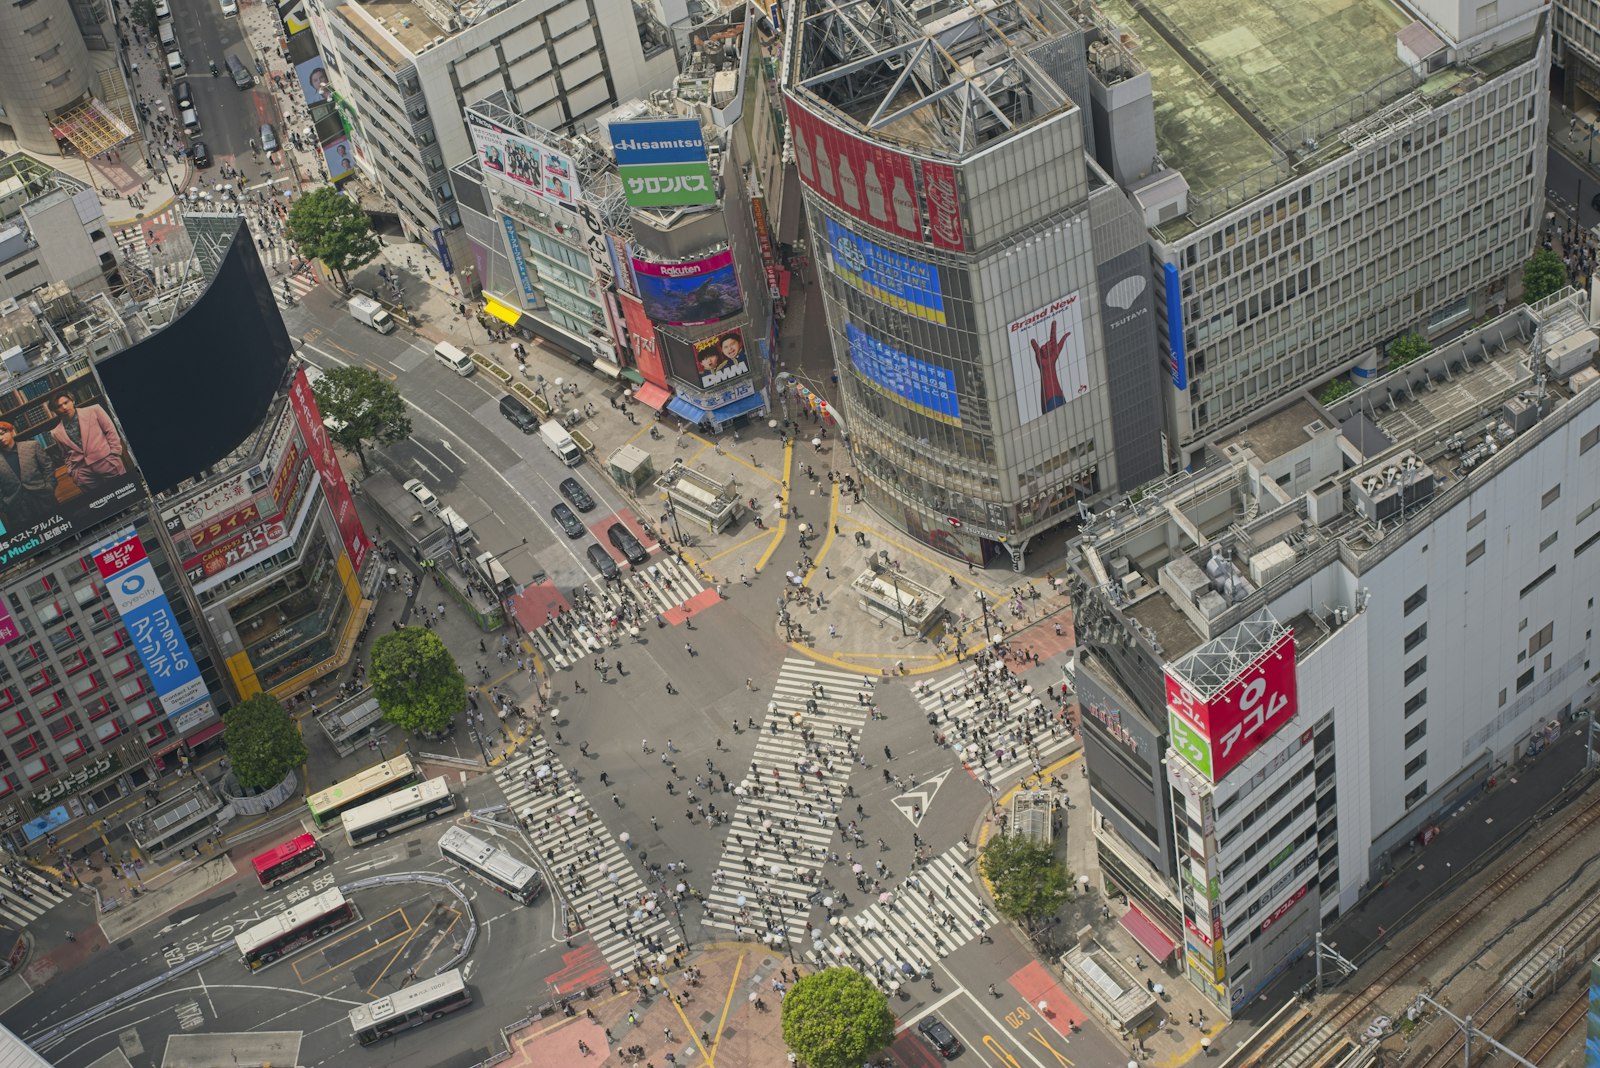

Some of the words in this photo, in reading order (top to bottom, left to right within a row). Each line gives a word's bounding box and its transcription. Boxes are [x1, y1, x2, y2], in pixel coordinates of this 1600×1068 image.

[614, 138, 703, 151] Hisamitsu
[627, 175, 709, 194] サロンパス
[660, 264, 701, 277] Rakuten
[1011, 308, 1047, 332] Brand
[1050, 295, 1077, 312] New
[1110, 307, 1148, 330] TSUTAYA
[702, 361, 749, 388] DMM
[89, 492, 115, 508] amazon
[115, 482, 135, 496] music
[204, 484, 245, 511] しゃぶ葉
[1022, 465, 1097, 508] STARBUCKS
[10, 514, 64, 544] ベストアルバム
[167, 520, 181, 530] 9F
[103, 544, 135, 565] 当ビル
[114, 554, 131, 569] 5F
[225, 538, 263, 564] ガスト
[188, 568, 203, 580] 7F
[121, 587, 156, 608] eyecity
[131, 616, 172, 677] アイシティ
[152, 608, 189, 671] コンタクトの
[163, 688, 186, 702] Contact
[1170, 691, 1206, 730] アコム
[1219, 691, 1288, 758] アコム
[1173, 718, 1203, 761] レイク
[37, 759, 111, 803] サンドラッグ
[1274, 899, 1294, 918] アコム
[1005, 1006, 1031, 1029] 8-20
